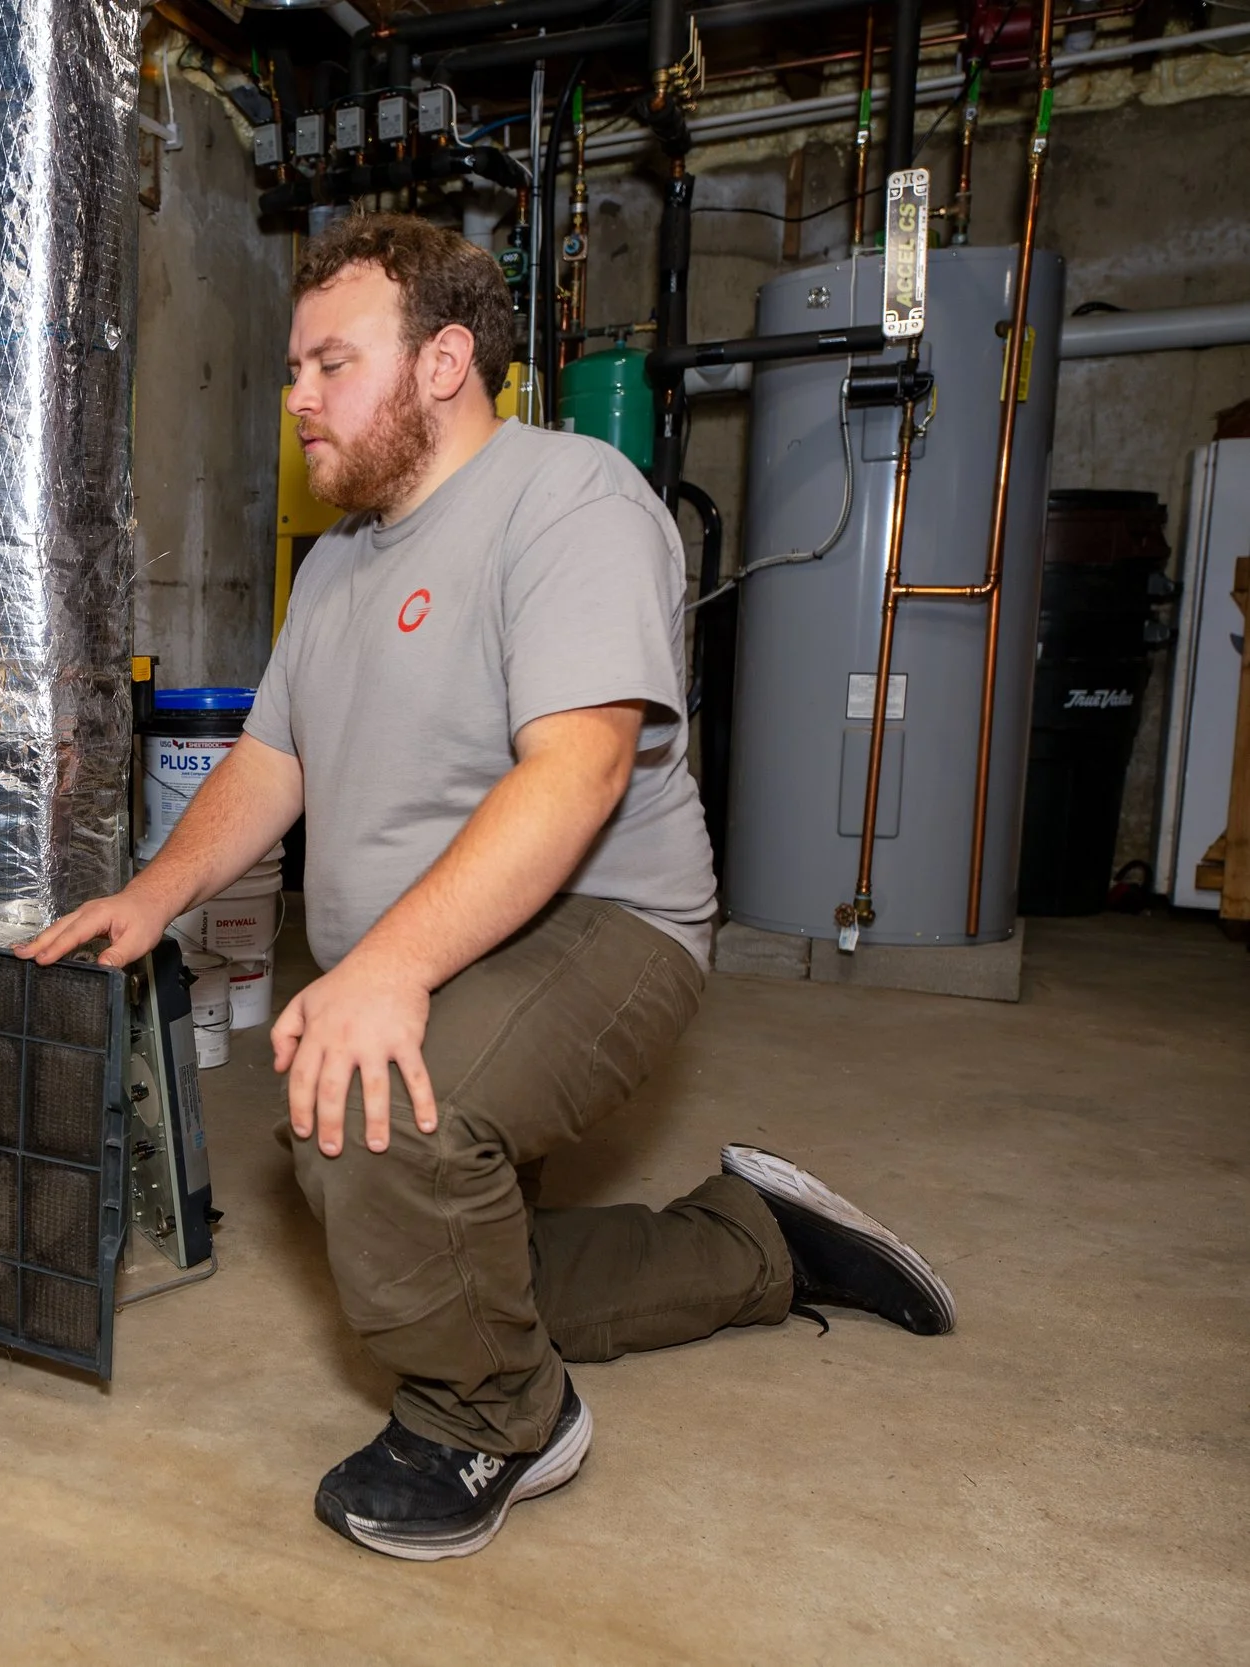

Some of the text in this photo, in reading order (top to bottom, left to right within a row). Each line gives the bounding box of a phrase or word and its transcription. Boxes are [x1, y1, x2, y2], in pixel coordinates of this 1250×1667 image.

[896, 203, 917, 308] ACCEL CS
[160, 754, 211, 771] PLUS 3
[216, 917, 257, 928] DRYWALL
